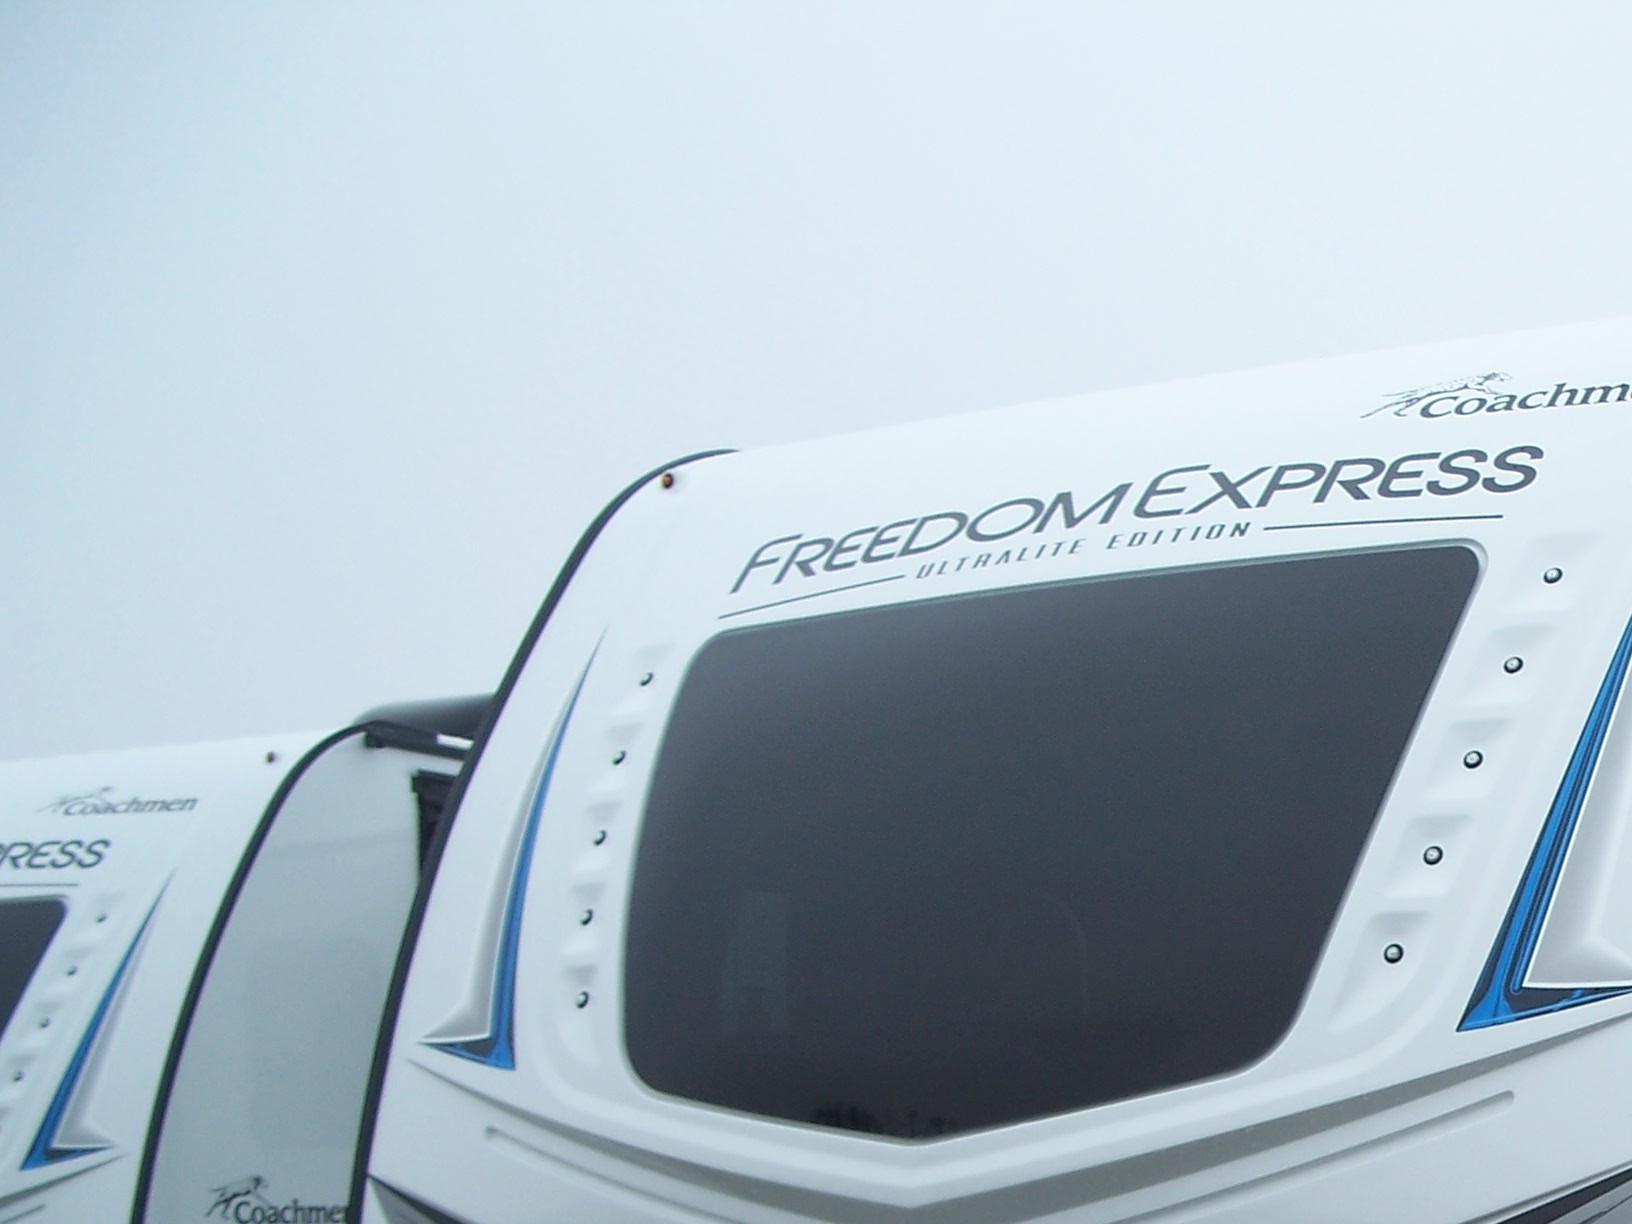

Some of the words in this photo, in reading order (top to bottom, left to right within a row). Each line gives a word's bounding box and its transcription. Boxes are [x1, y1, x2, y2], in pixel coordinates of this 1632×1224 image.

[730, 482, 1134, 595] FREEDOM
[1132, 445, 1545, 519] EXPRESS
[915, 537, 1087, 579] ULTRALITE
[1106, 521, 1251, 550] EDITION
[62, 796, 199, 816] Coachmen
[0, 838, 111, 869] RESS
